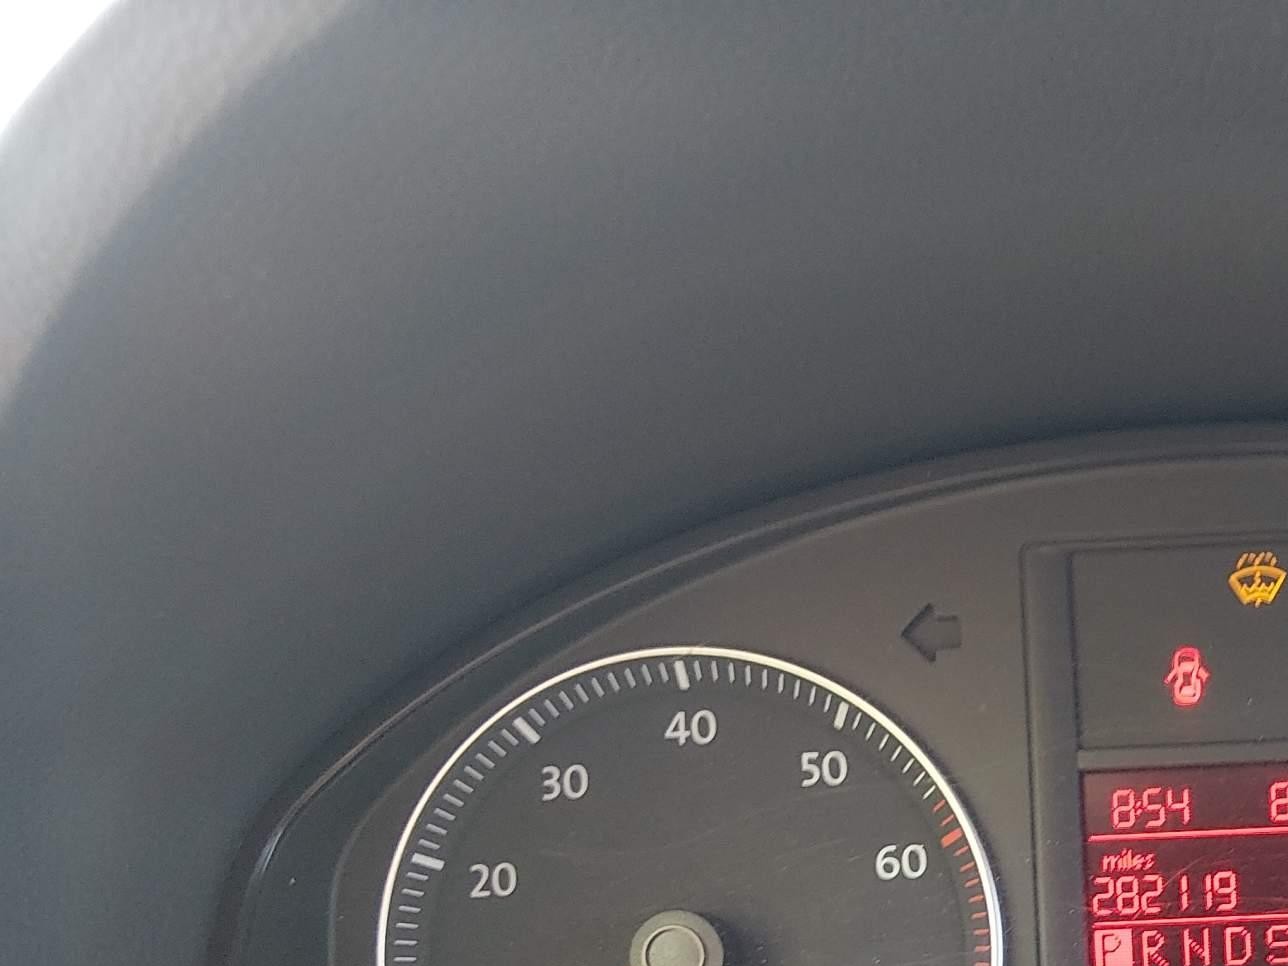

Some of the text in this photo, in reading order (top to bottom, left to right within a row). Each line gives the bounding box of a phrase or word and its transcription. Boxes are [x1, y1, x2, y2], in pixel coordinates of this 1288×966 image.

[664, 710, 717, 746] 40
[542, 764, 589, 800] 30
[800, 750, 848, 786] 50
[1113, 787, 1191, 829] 8:54
[876, 844, 927, 880] 60
[1102, 848, 1155, 871] miles
[469, 862, 517, 898] 20
[1093, 870, 1237, 915] 282119
[1224, 926, 1252, 966] D
